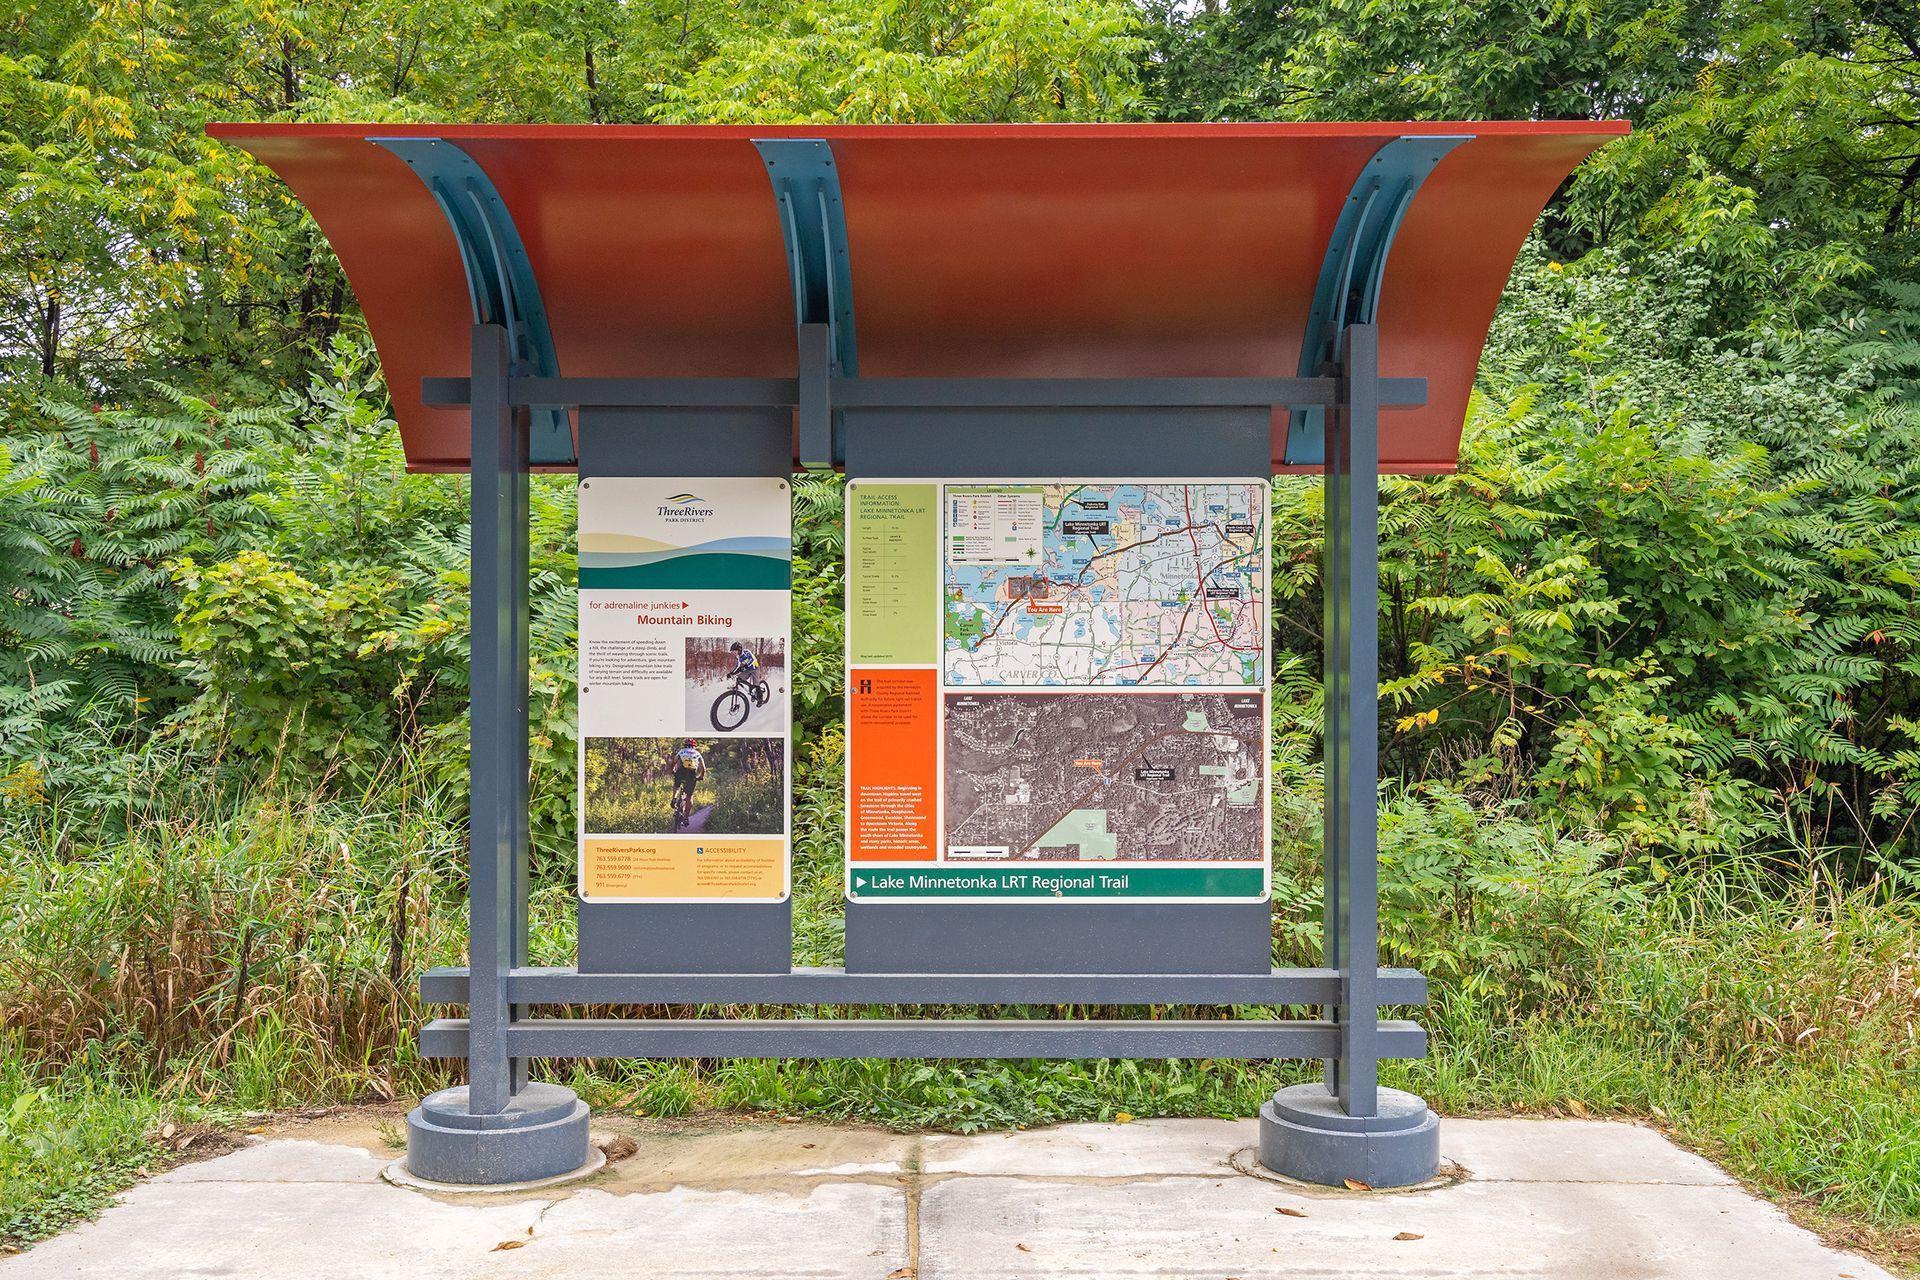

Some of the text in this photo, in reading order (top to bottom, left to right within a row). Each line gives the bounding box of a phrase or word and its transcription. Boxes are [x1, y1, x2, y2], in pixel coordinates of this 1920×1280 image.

[657, 506, 714, 516] ThreeRivers
[589, 601, 680, 611] for adrenaline junkies
[637, 615, 733, 628] Mountain Biking
[1000, 671, 1060, 679] CARVER CO.
[871, 876, 1128, 892] Lake Minnetonka LRT Regional Trail
